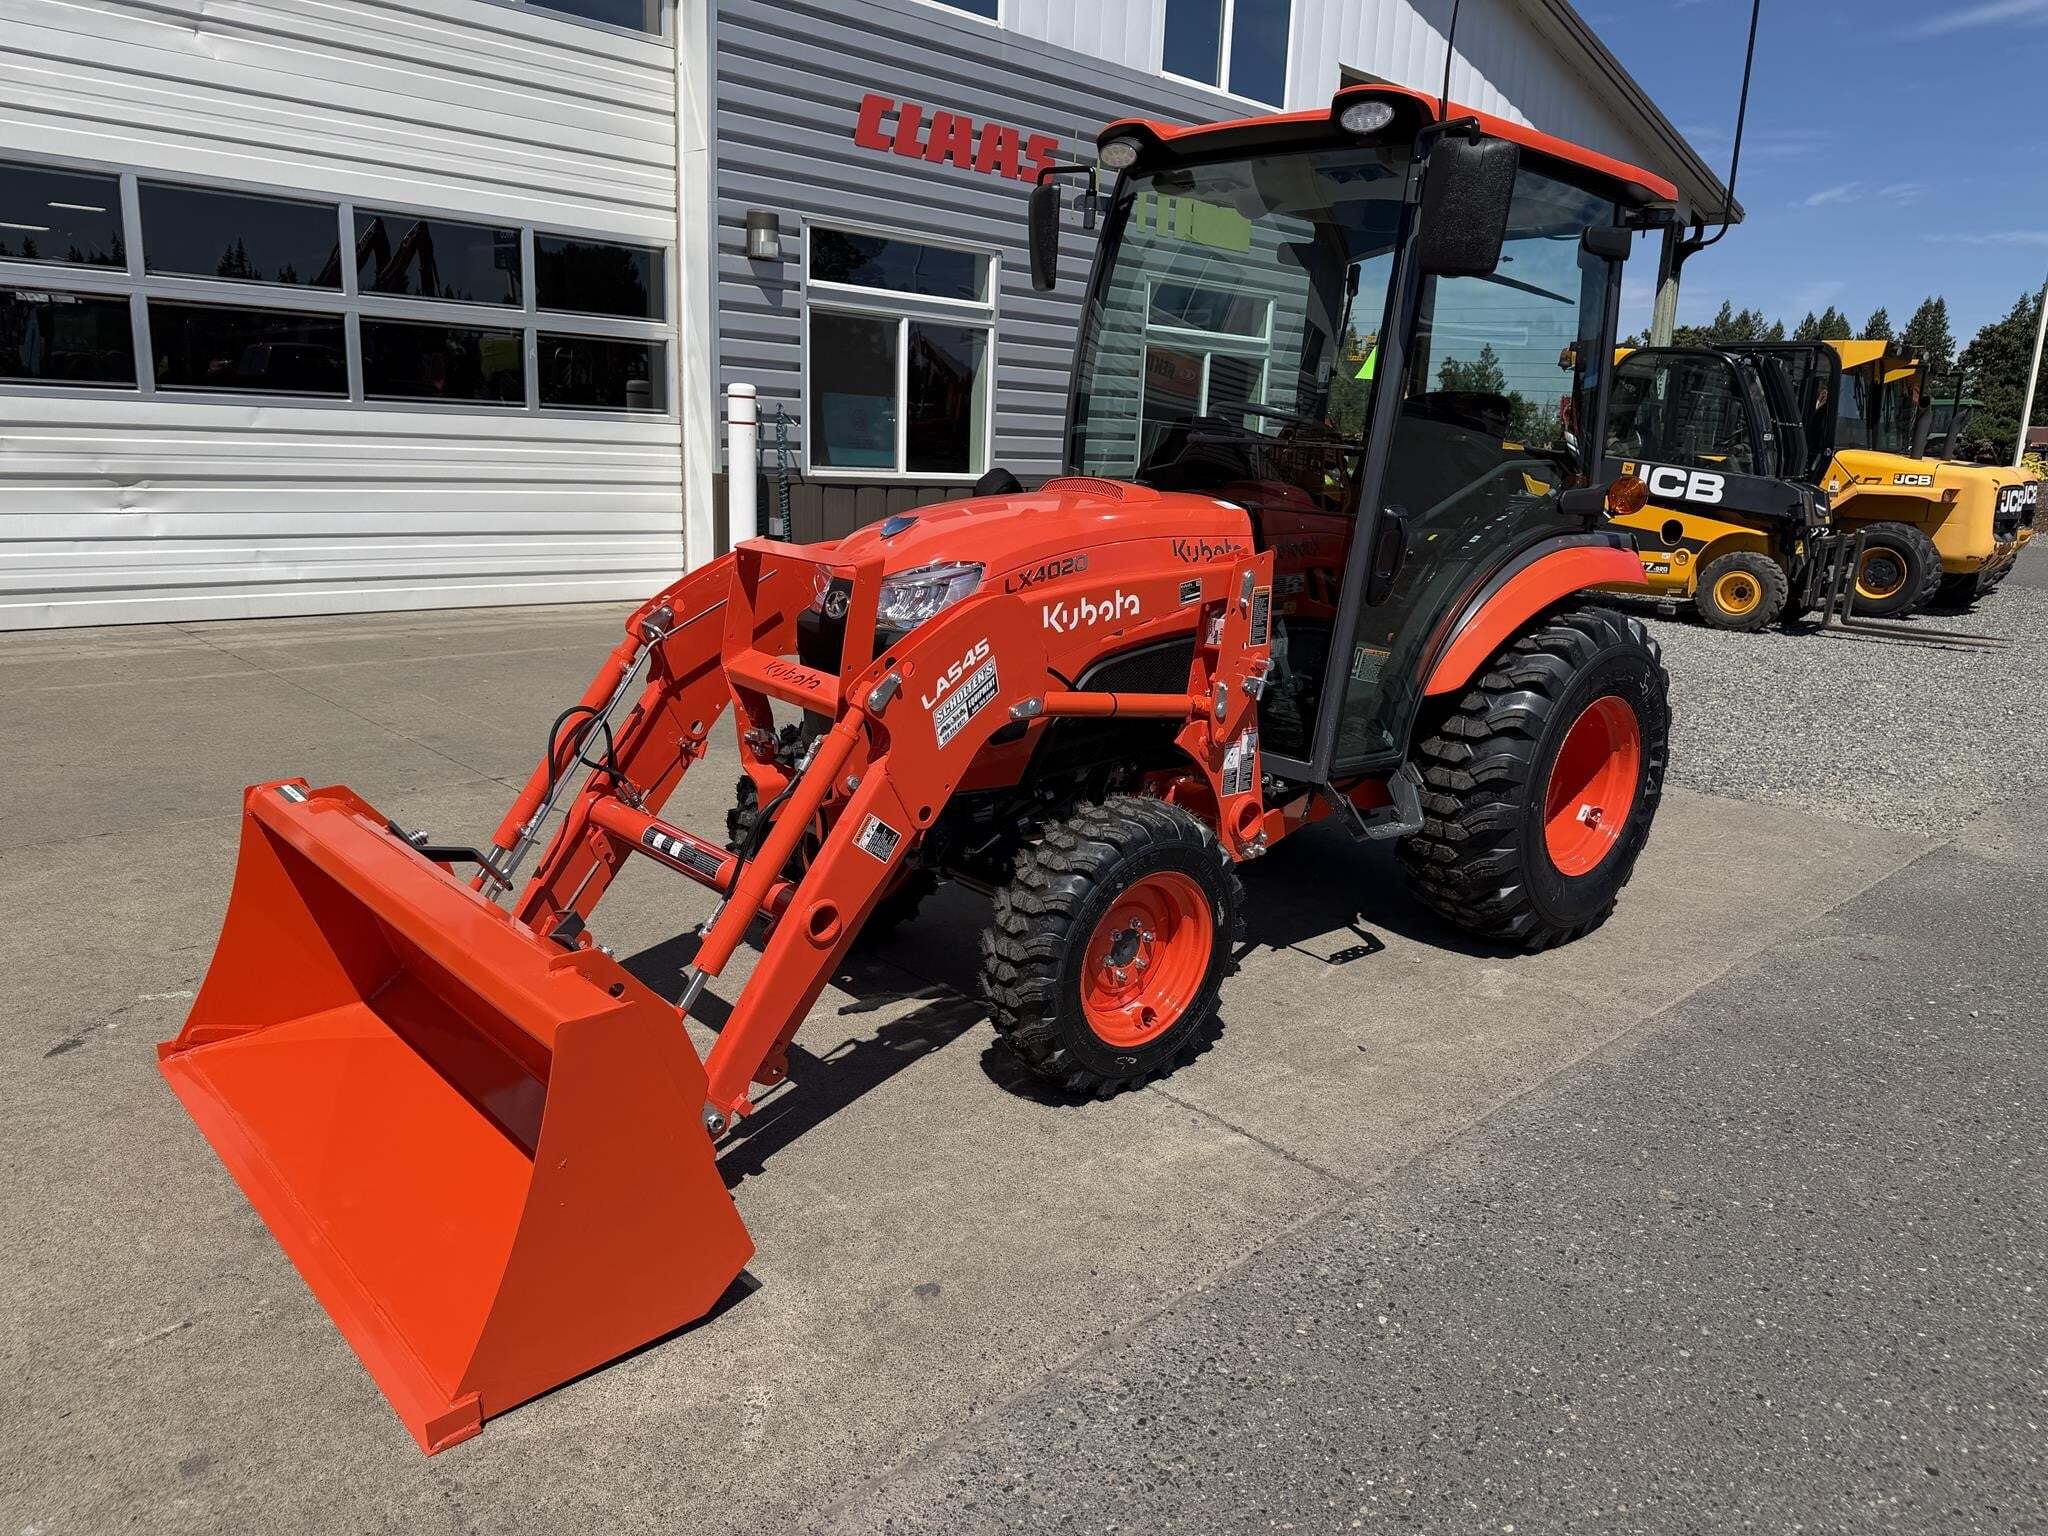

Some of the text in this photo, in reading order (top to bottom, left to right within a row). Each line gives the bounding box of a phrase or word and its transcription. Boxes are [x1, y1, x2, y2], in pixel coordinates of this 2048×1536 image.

[854, 94, 1059, 185] CLAAS
[1893, 475, 1932, 486] JCB
[2000, 490, 2025, 513] JCB
[1004, 554, 1089, 595] LX4020
[1043, 590, 1140, 633] Kubota
[764, 661, 821, 690] Kubota
[921, 637, 990, 710] LA545
[936, 662, 995, 725] SCHOLTEN'S
[967, 677, 996, 708] EQUIPMENT
